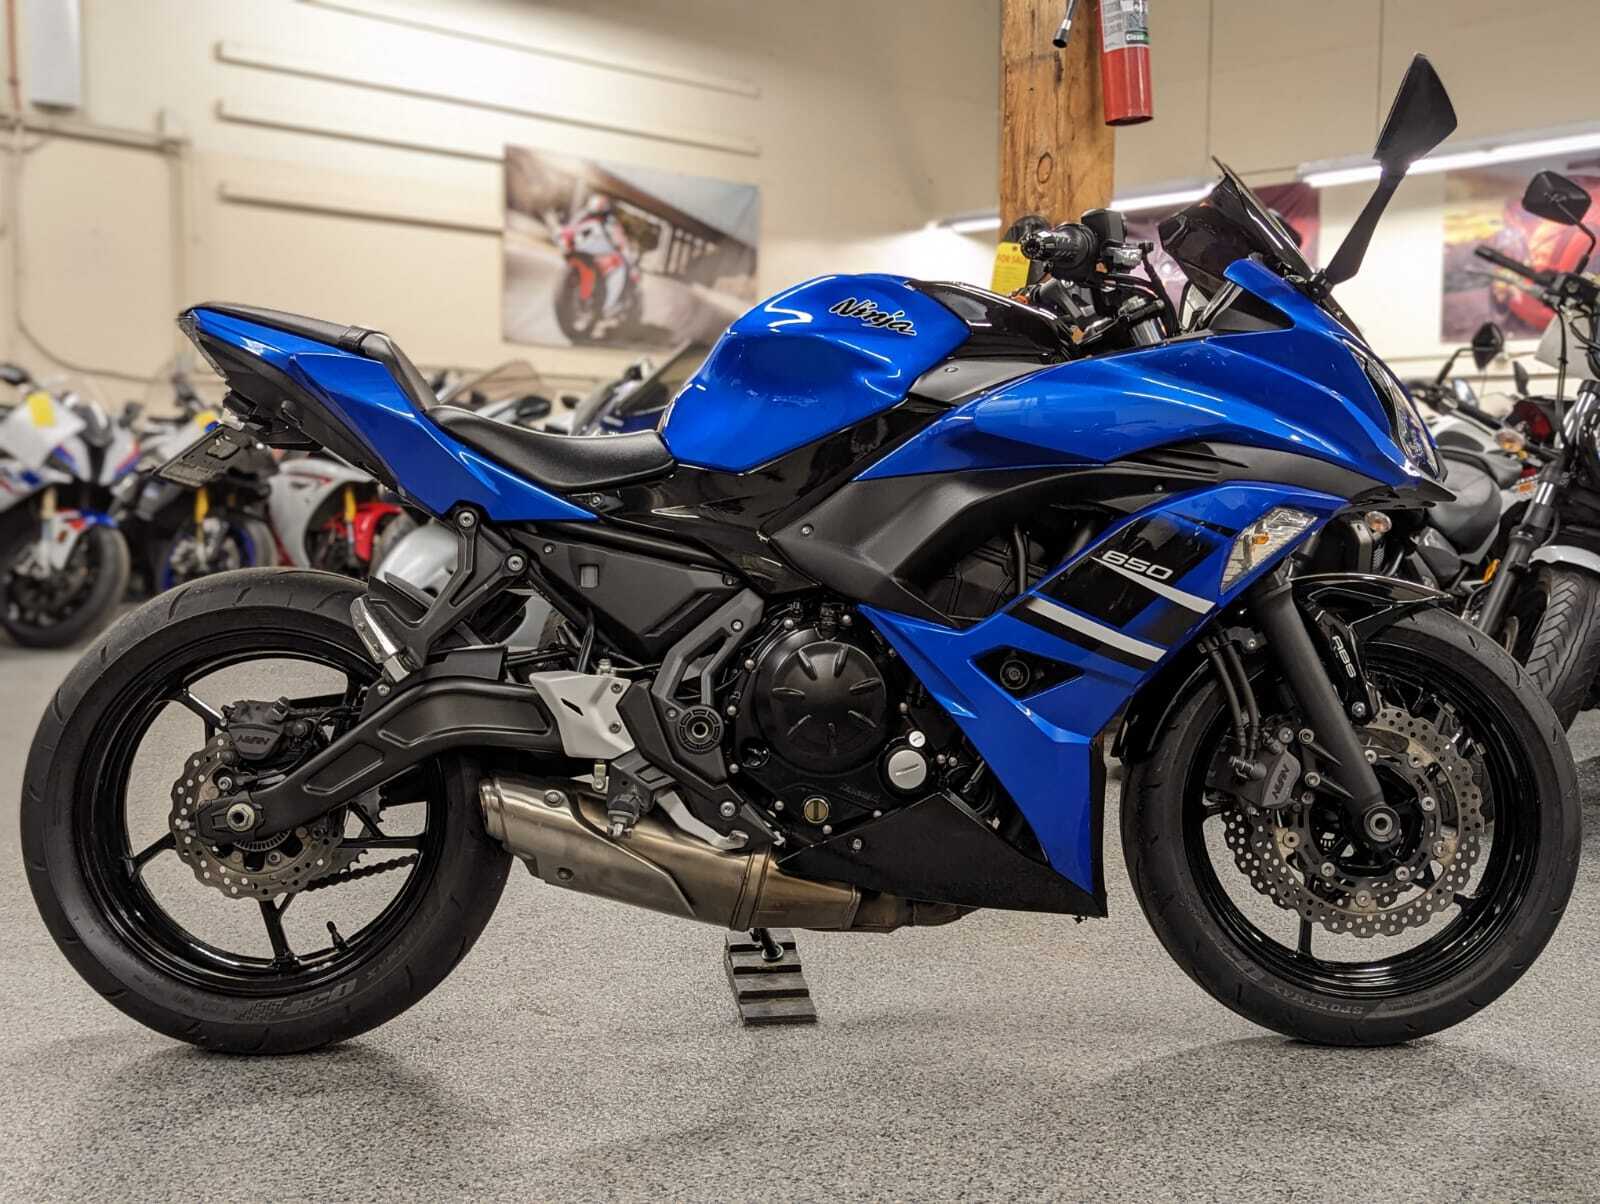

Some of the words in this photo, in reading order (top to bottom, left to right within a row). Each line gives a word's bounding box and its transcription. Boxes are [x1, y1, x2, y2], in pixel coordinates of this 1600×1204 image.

[828, 297, 917, 336] Ninja
[1101, 550, 1174, 580] 650
[1331, 635, 1357, 679] ABS
